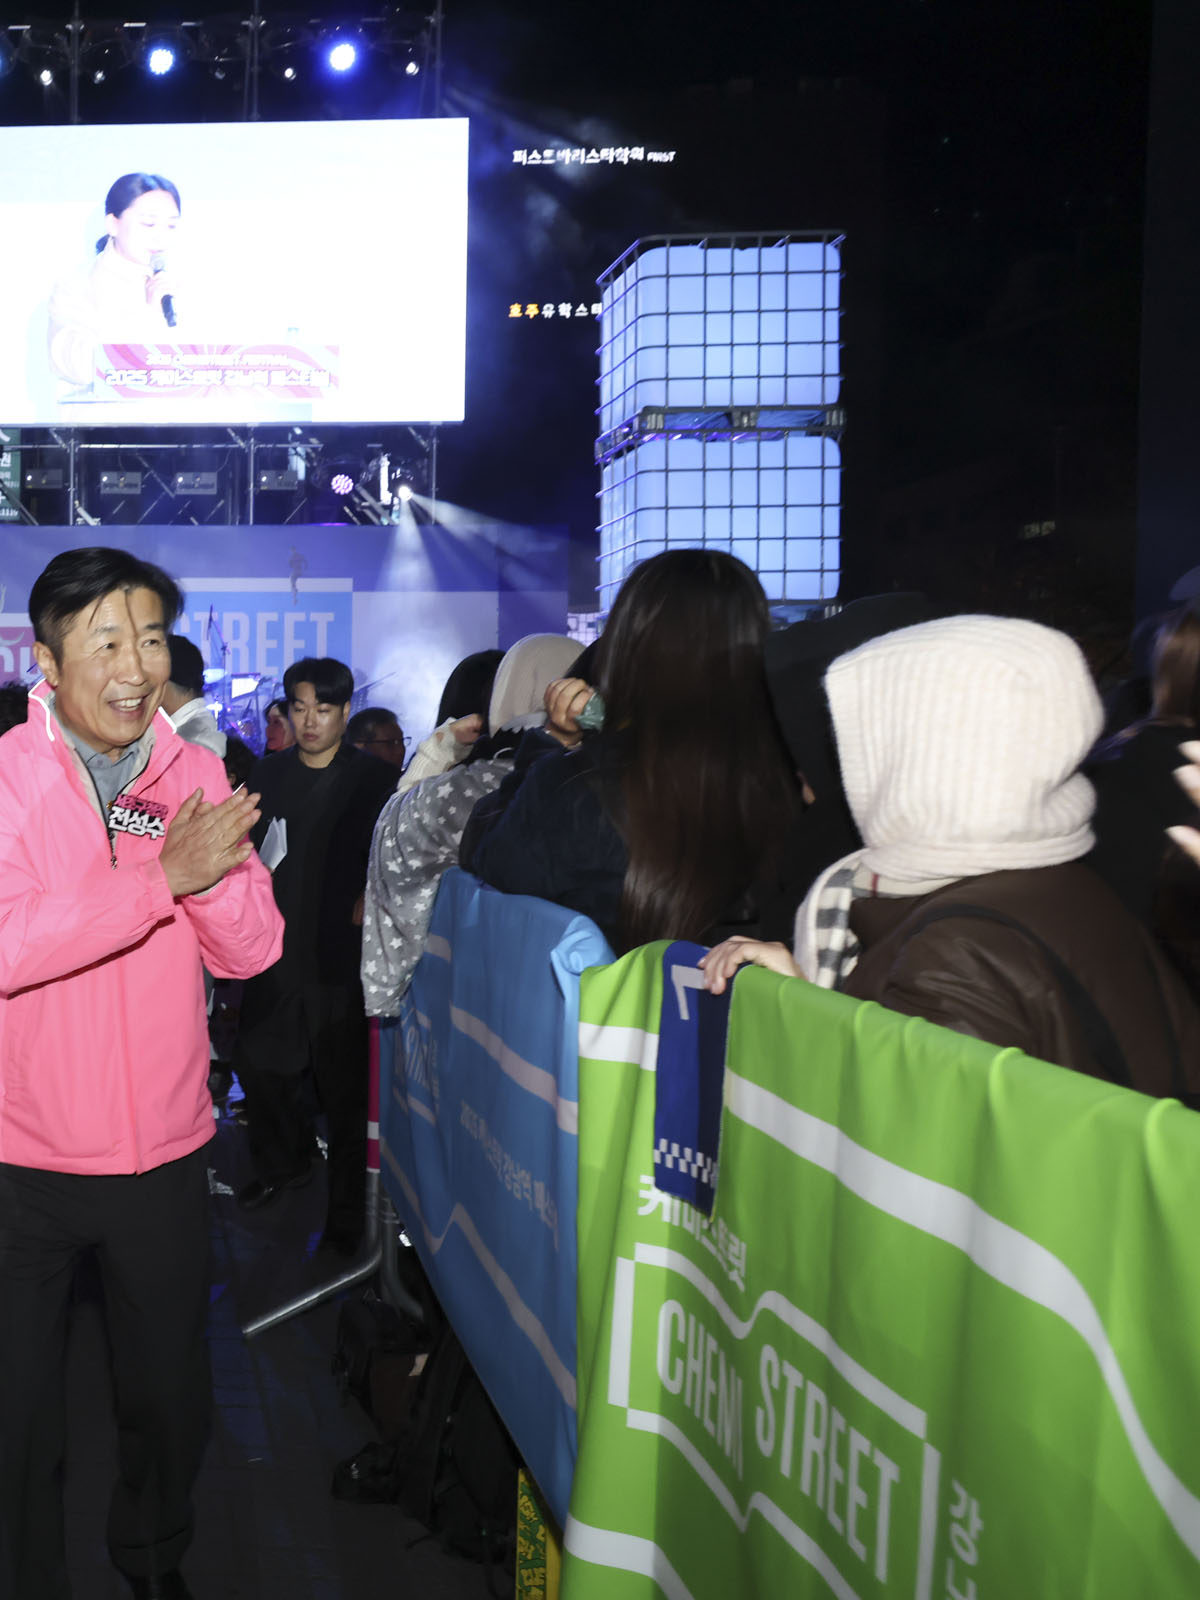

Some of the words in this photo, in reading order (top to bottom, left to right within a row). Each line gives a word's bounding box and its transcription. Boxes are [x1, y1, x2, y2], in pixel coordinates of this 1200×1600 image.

[105, 369, 147, 386] 2025
[108, 805, 165, 840] 전성수
[756, 1344, 899, 1584] STREET
